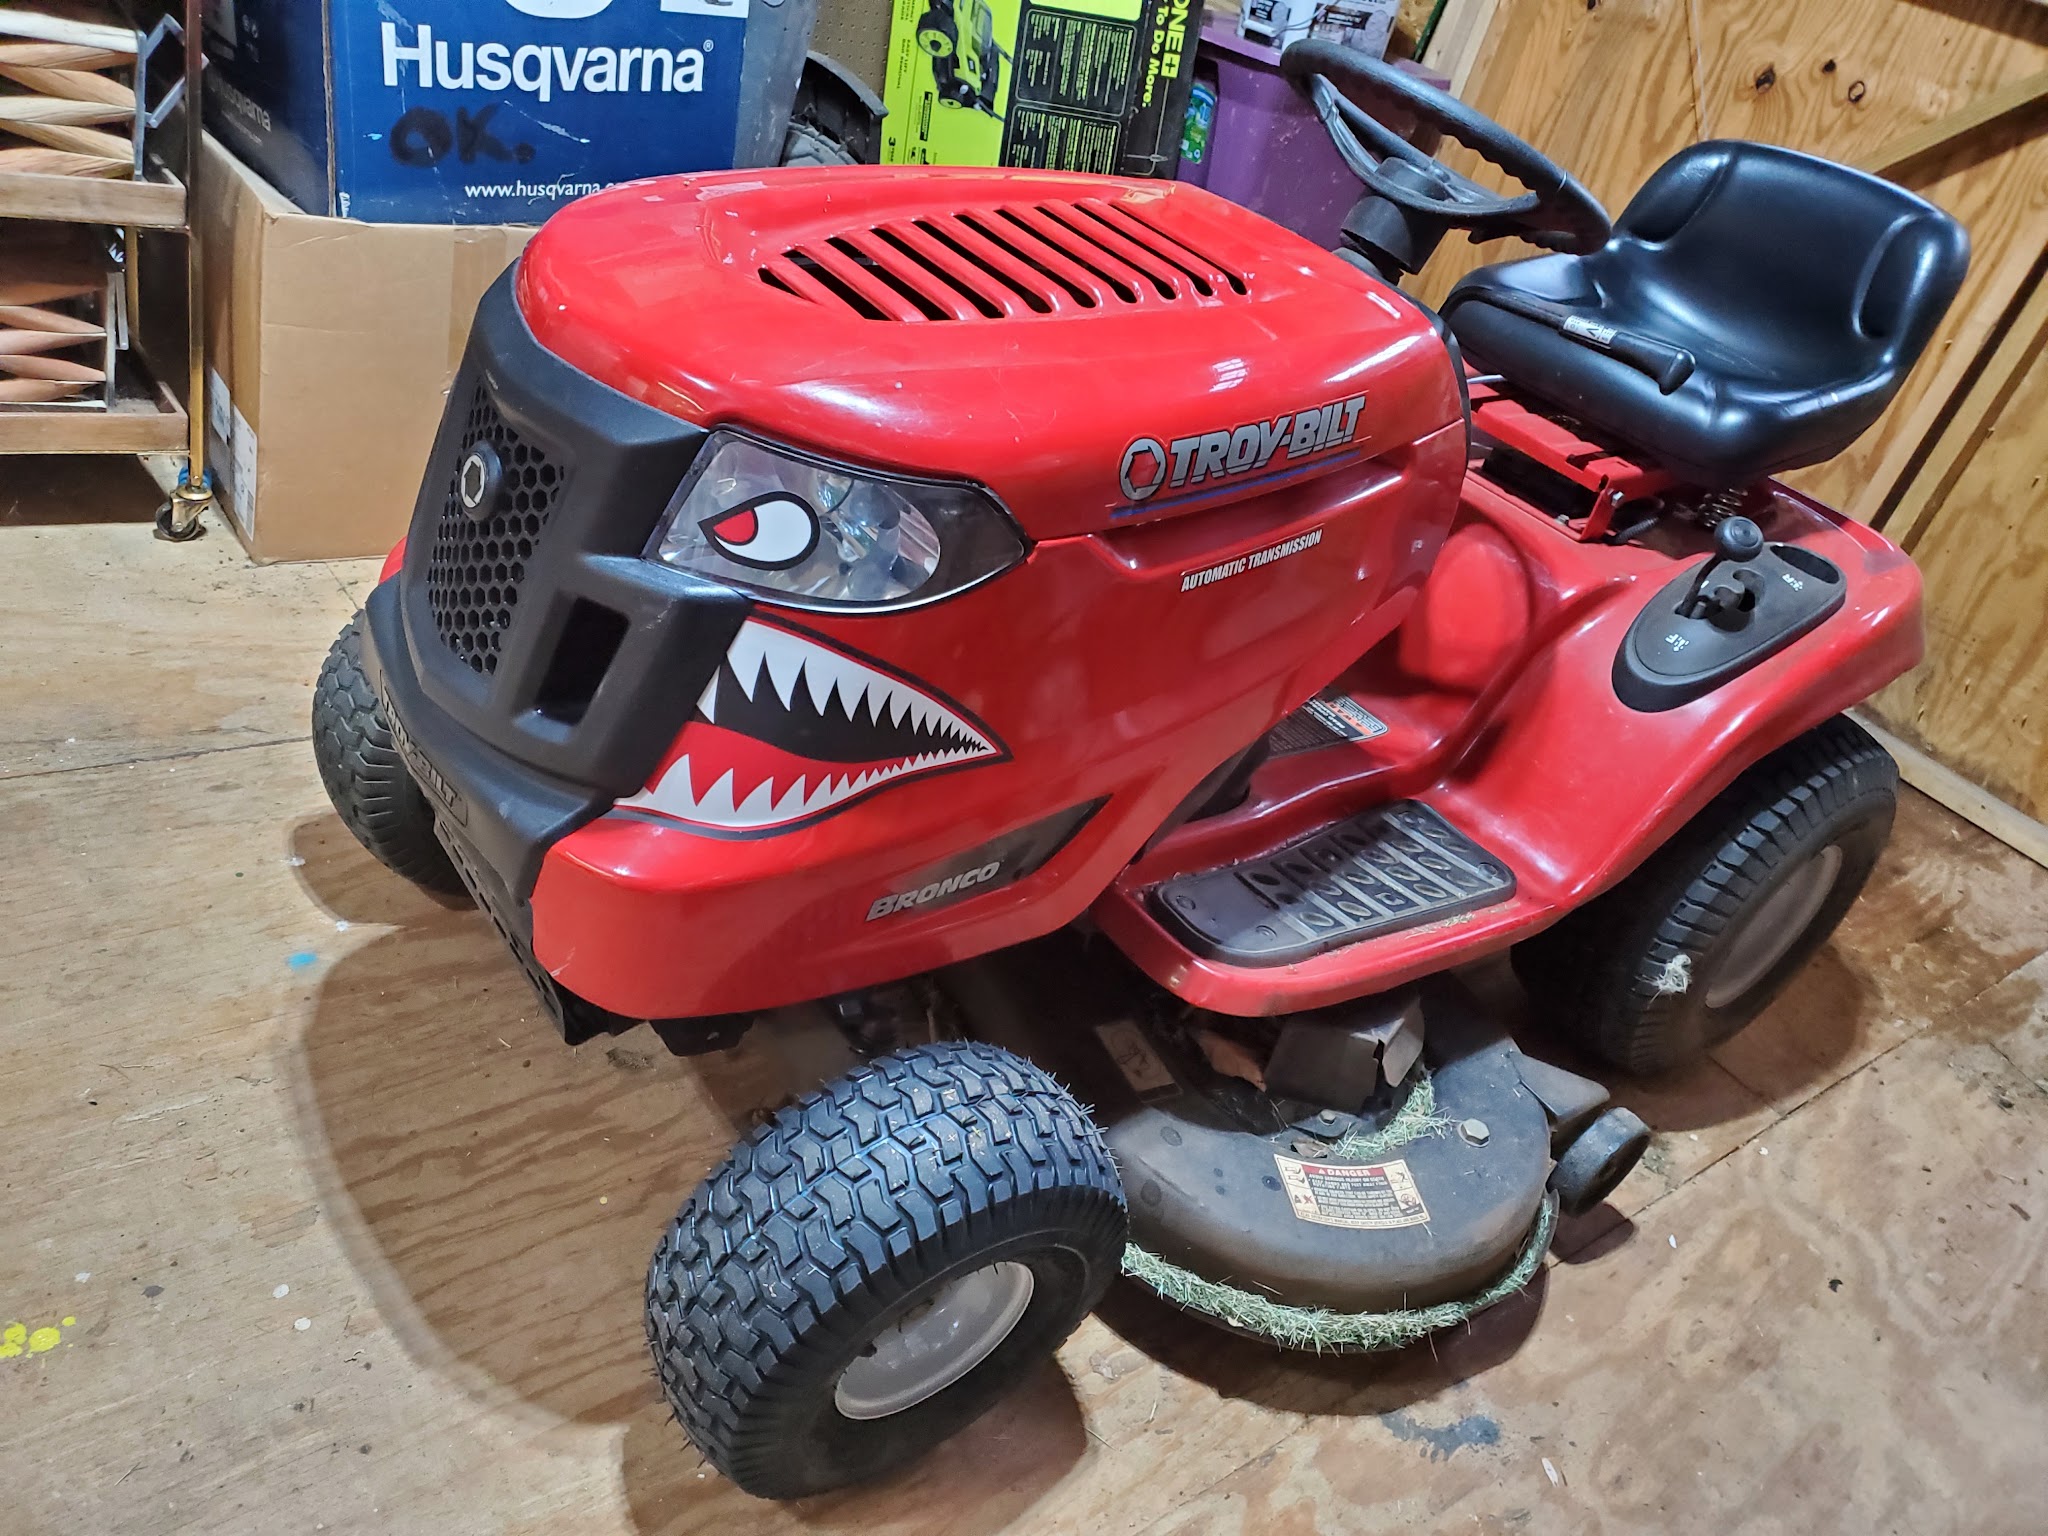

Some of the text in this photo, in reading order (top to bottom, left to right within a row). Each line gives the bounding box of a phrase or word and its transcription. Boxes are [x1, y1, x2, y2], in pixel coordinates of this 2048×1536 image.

[1142, 6, 1169, 108] To Do More:
[888, 136, 896, 147] 3
[1168, 396, 1366, 487] TROY-BILT
[1180, 528, 1323, 593] AUTOMATIC TRANSMISSION
[865, 861, 1001, 922] BRONCO
[1327, 1168, 1371, 1177] DANGER
